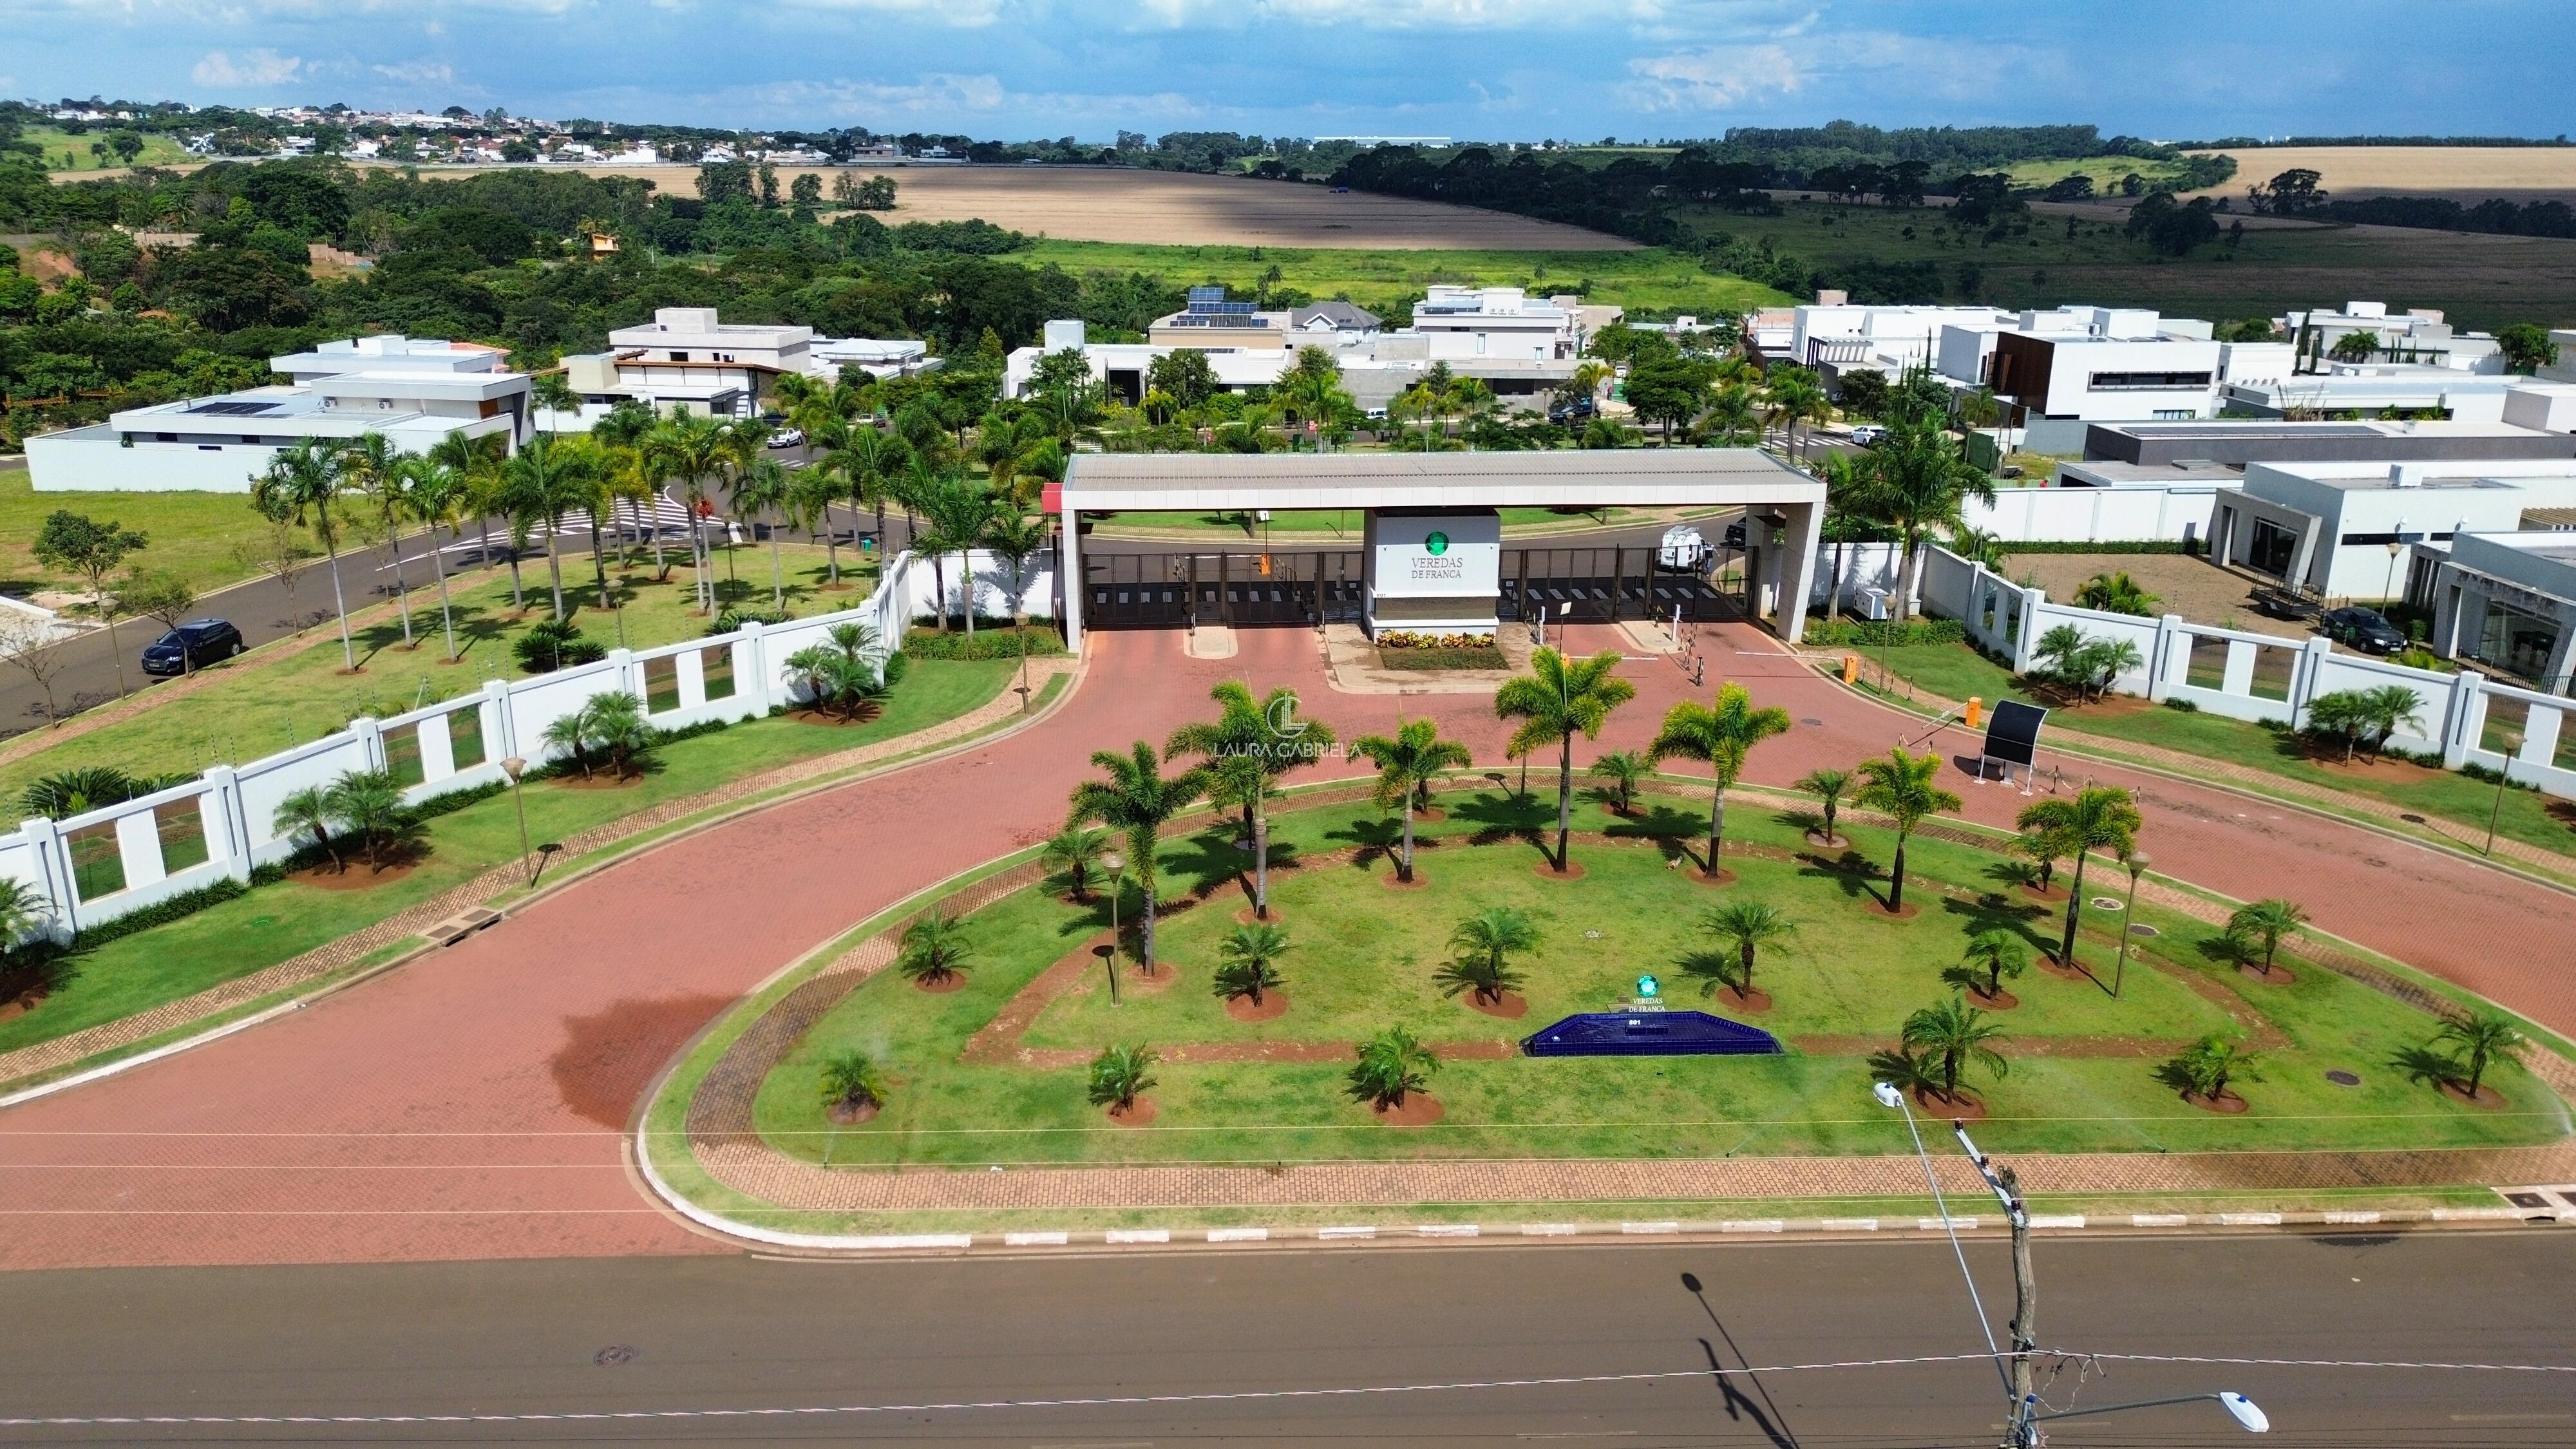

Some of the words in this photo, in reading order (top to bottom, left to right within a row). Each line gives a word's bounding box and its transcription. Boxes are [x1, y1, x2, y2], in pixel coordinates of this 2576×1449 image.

[1412, 557, 1463, 568] VEREDAS
[1412, 570, 1424, 579] DE
[1425, 570, 1462, 579] FRANCA
